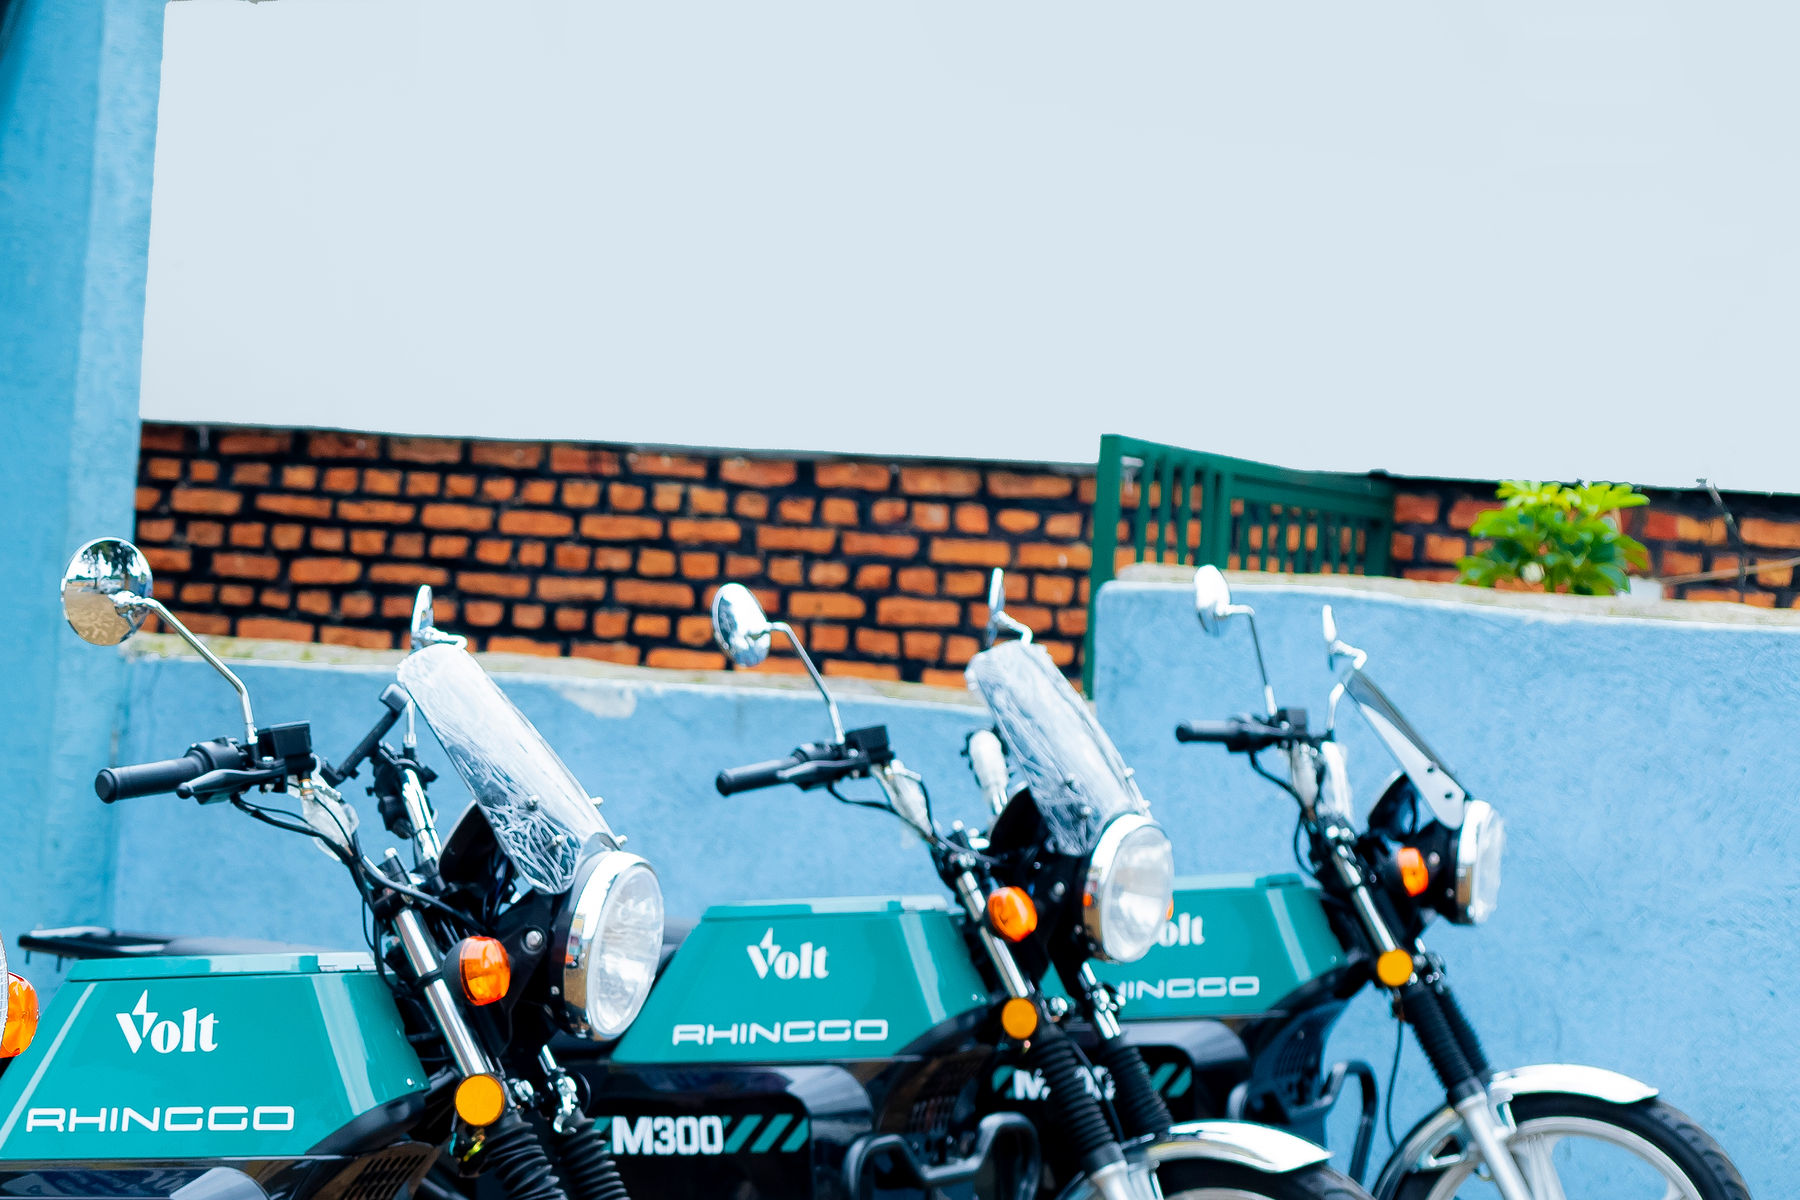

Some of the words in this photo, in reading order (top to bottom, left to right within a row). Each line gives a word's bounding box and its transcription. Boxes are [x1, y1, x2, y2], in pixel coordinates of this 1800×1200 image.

[1157, 912, 1205, 947] olt
[746, 927, 830, 980] Volt
[1118, 976, 1260, 999] INGGO
[116, 989, 220, 1054] Volt
[672, 1019, 889, 1045] RHINGGO
[26, 1106, 295, 1132] RHINGGO
[612, 1115, 724, 1155] M300
